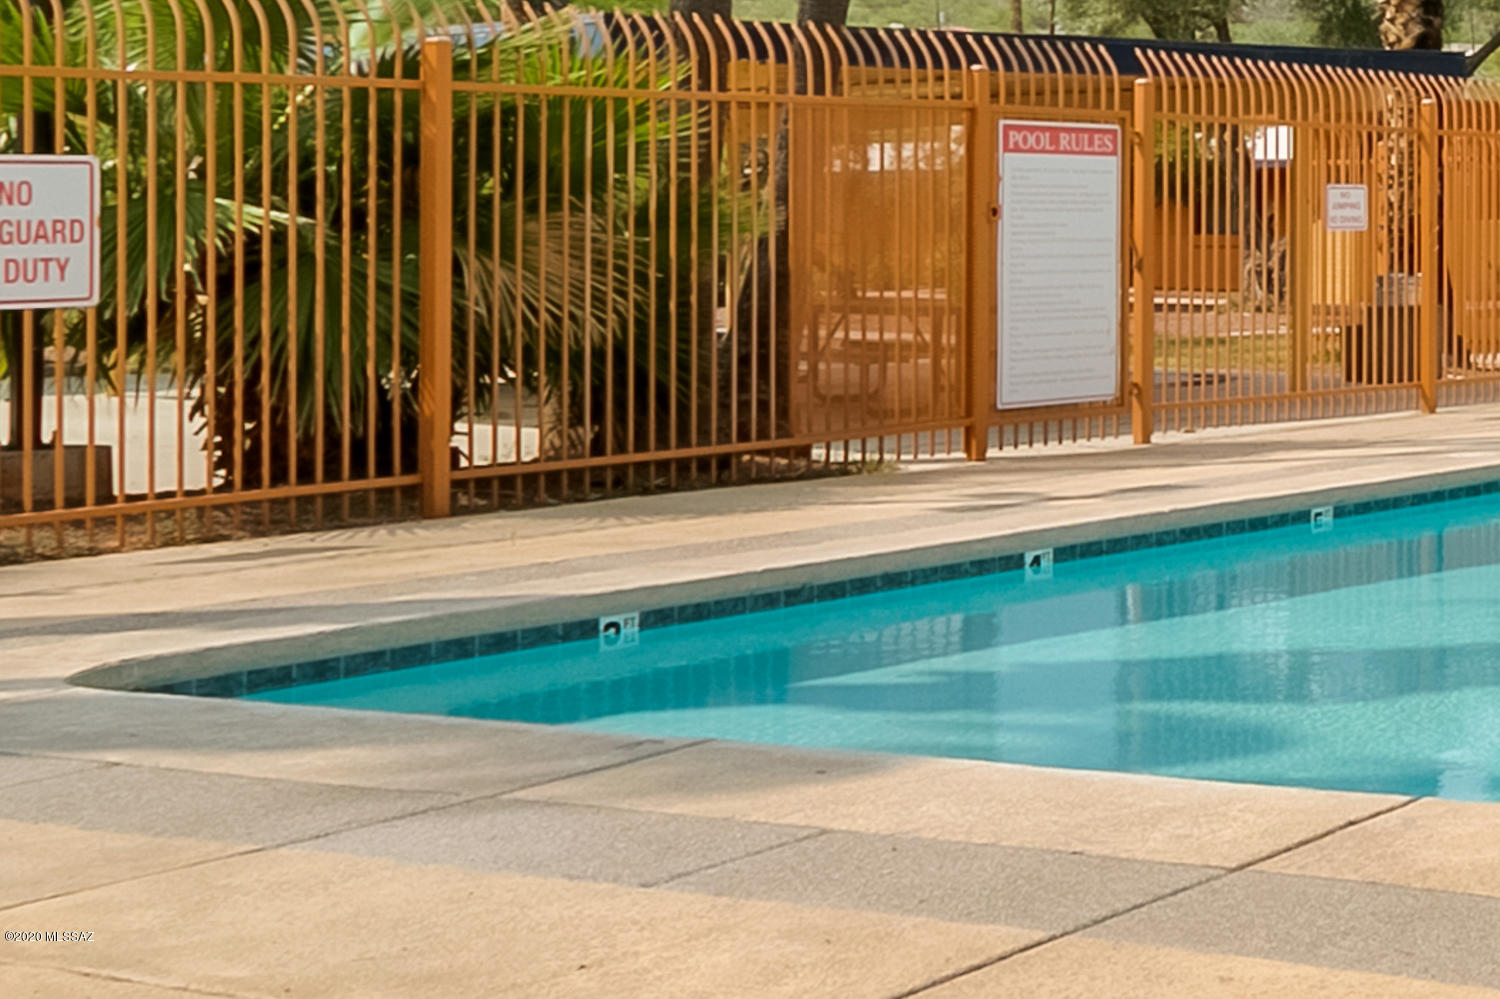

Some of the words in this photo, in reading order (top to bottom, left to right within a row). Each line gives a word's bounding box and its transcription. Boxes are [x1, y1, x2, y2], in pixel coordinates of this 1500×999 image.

[1008, 130, 1056, 150] POOL
[1060, 132, 1113, 152] RULES
[0, 180, 33, 206] NO
[0, 219, 84, 245] GUARD
[4, 257, 70, 284] DUTY
